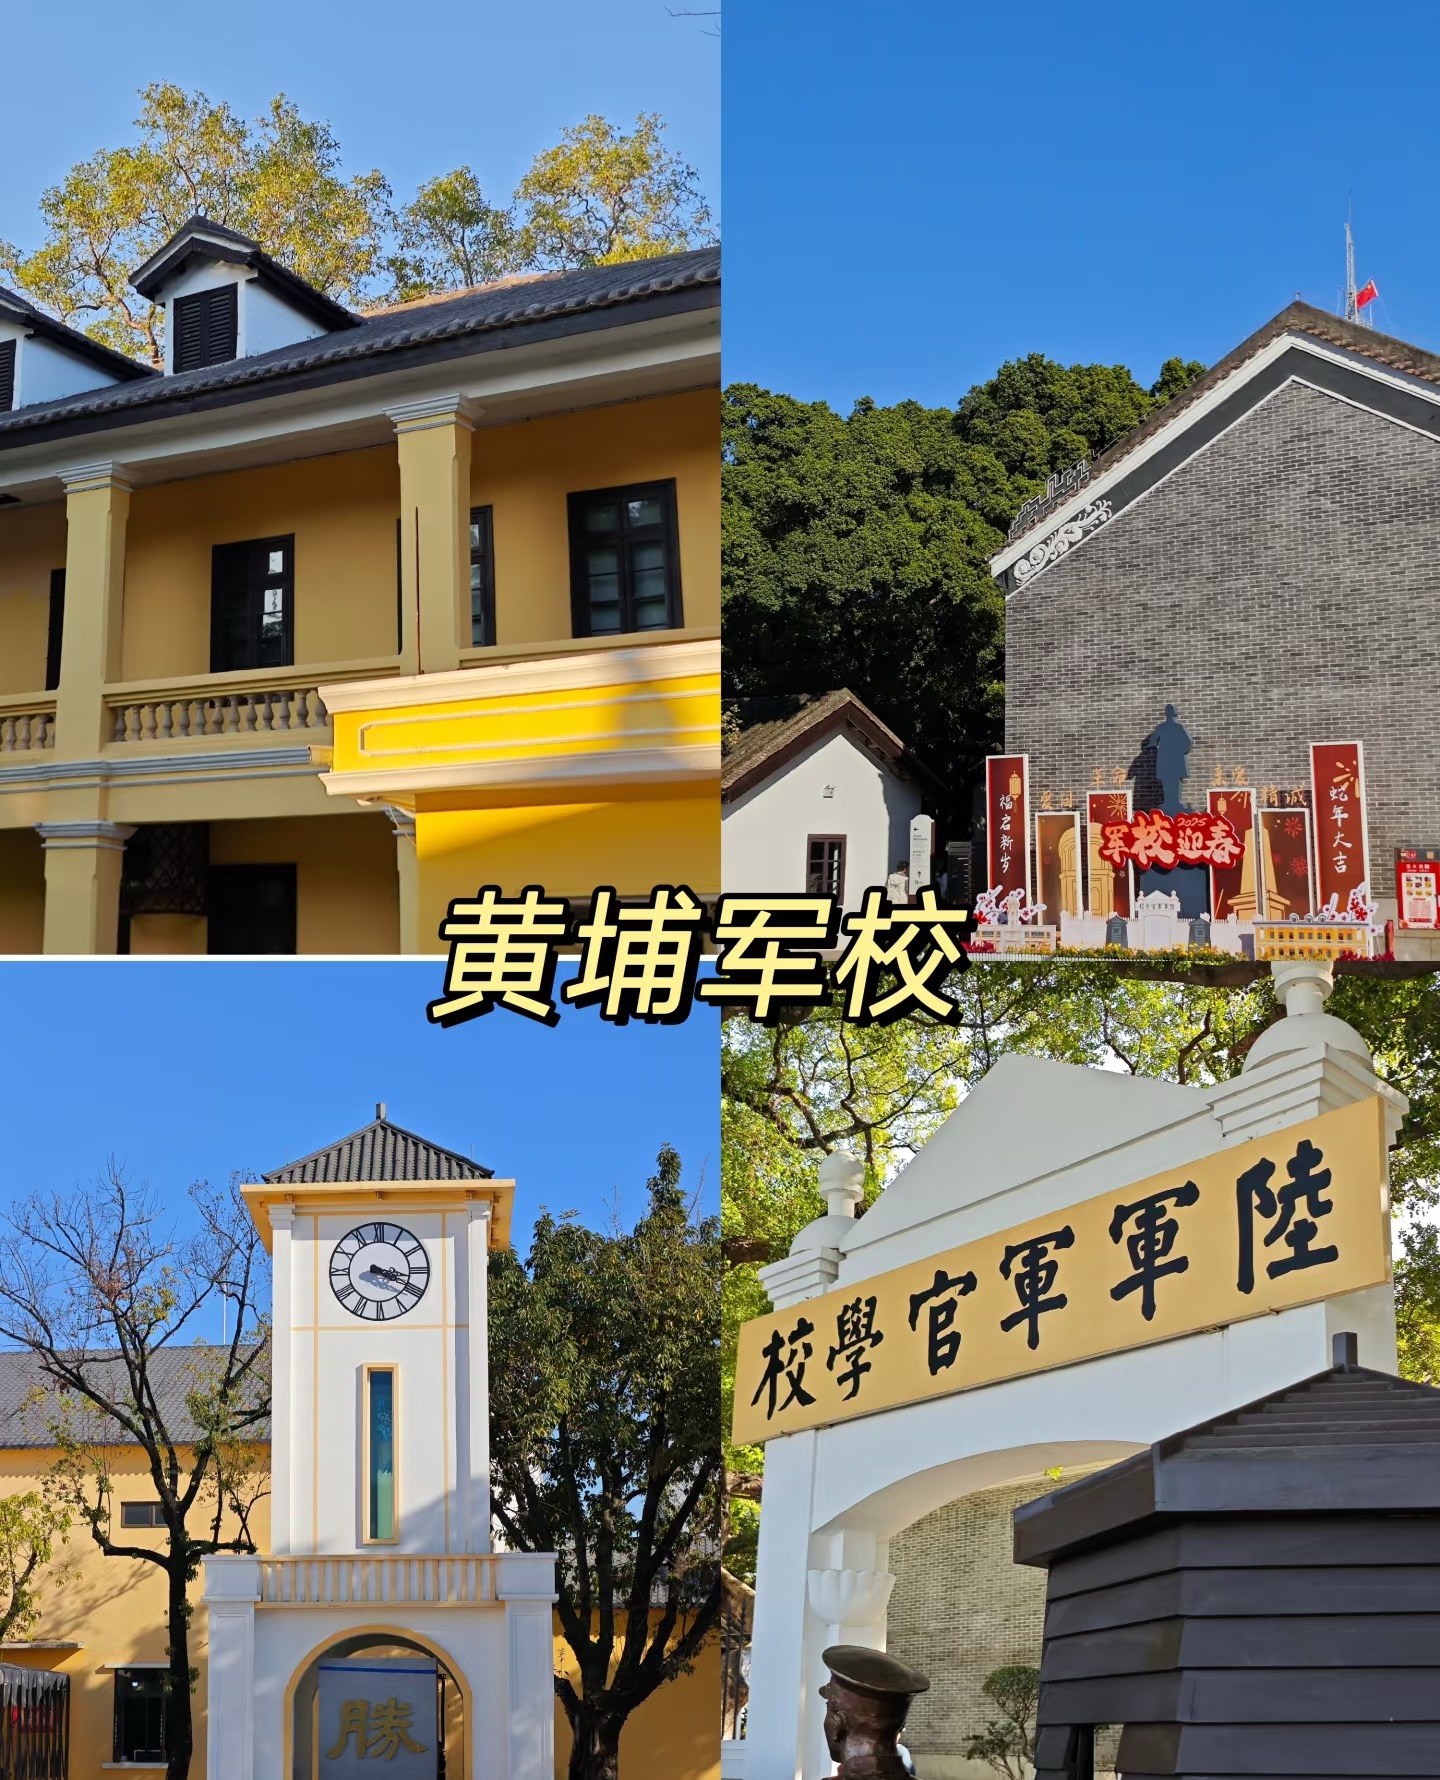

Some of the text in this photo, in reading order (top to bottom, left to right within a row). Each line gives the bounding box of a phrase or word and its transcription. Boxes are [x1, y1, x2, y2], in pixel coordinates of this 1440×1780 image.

[999, 794, 1014, 874] 福启新岁
[1329, 784, 1353, 873] 蛇年大吉
[326, 1696, 429, 1761] 勝
